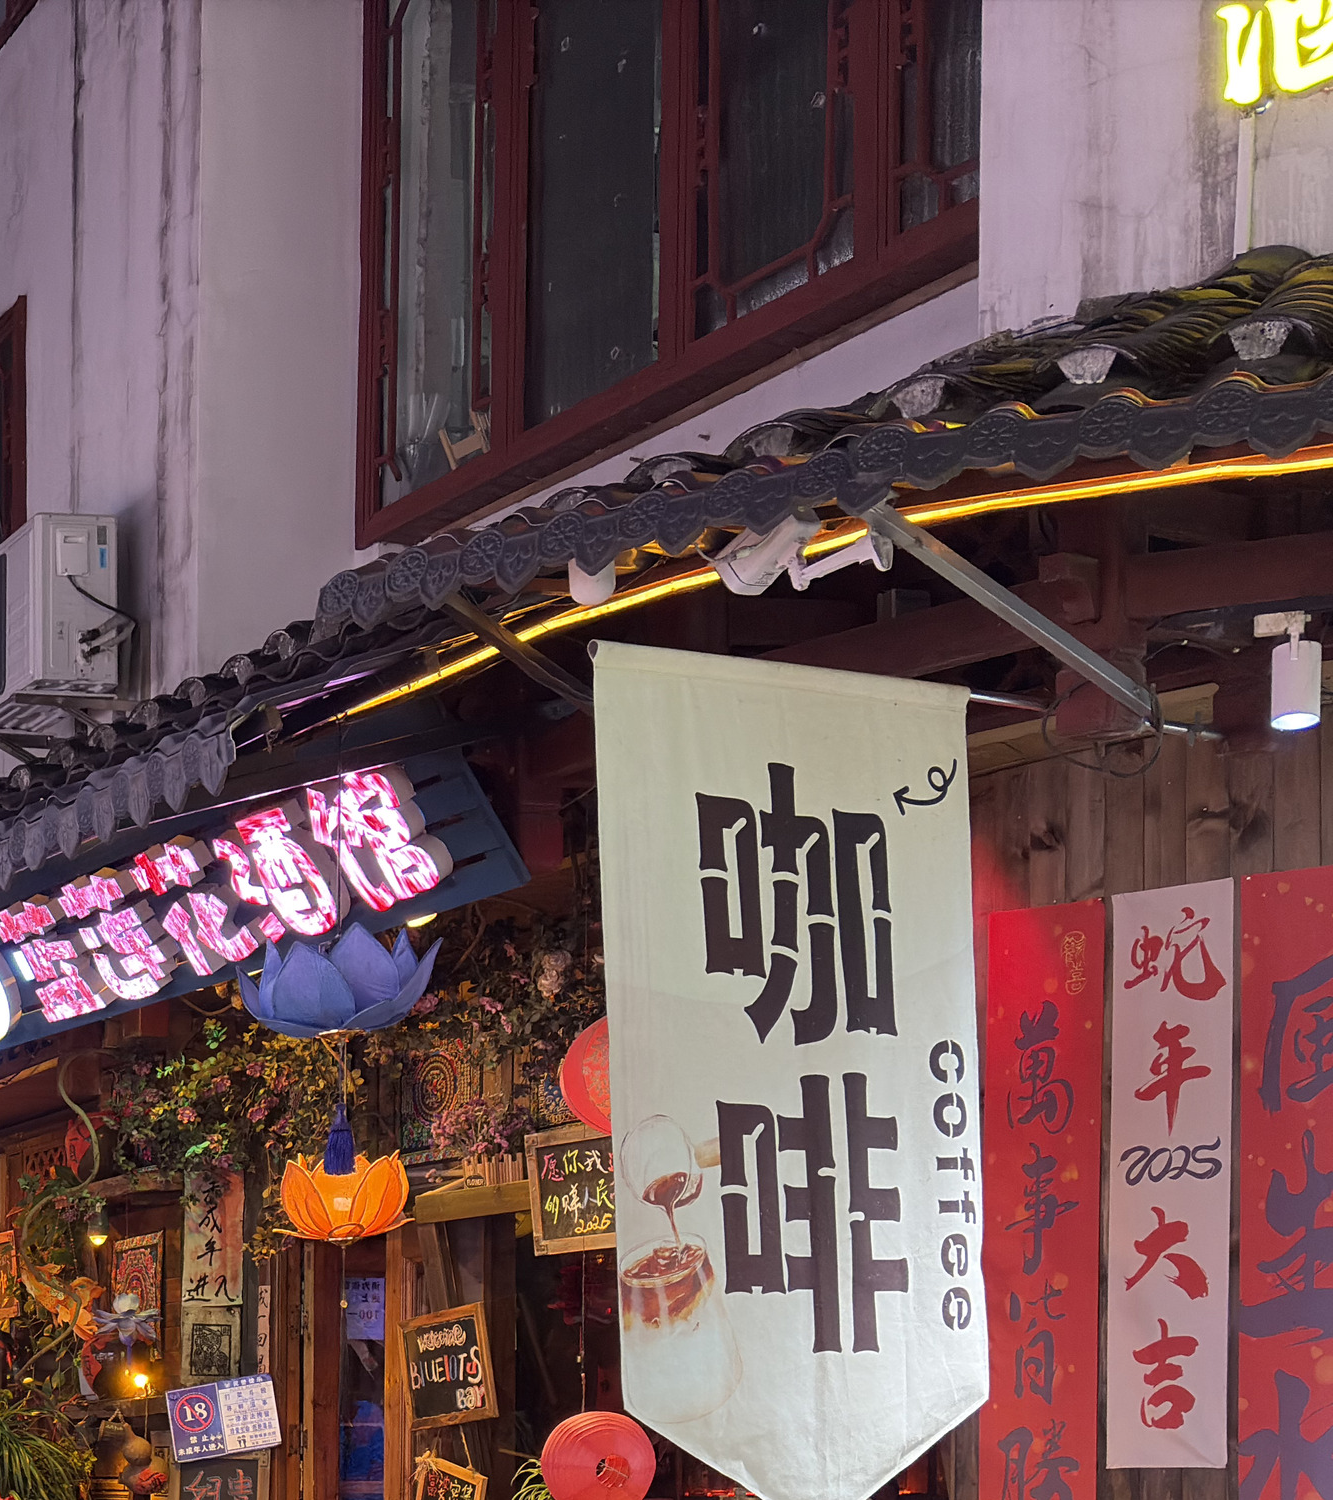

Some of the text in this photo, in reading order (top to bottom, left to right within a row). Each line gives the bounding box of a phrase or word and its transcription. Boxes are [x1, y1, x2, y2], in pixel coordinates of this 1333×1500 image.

[695, 762, 908, 1354] 咖啡
[927, 1038, 977, 1332] coffee
[1119, 906, 1226, 1430] 蛇年 2025 大吉
[178, 1442, 224, 1456] 未成年人进入
[183, 1402, 208, 1422] 18
